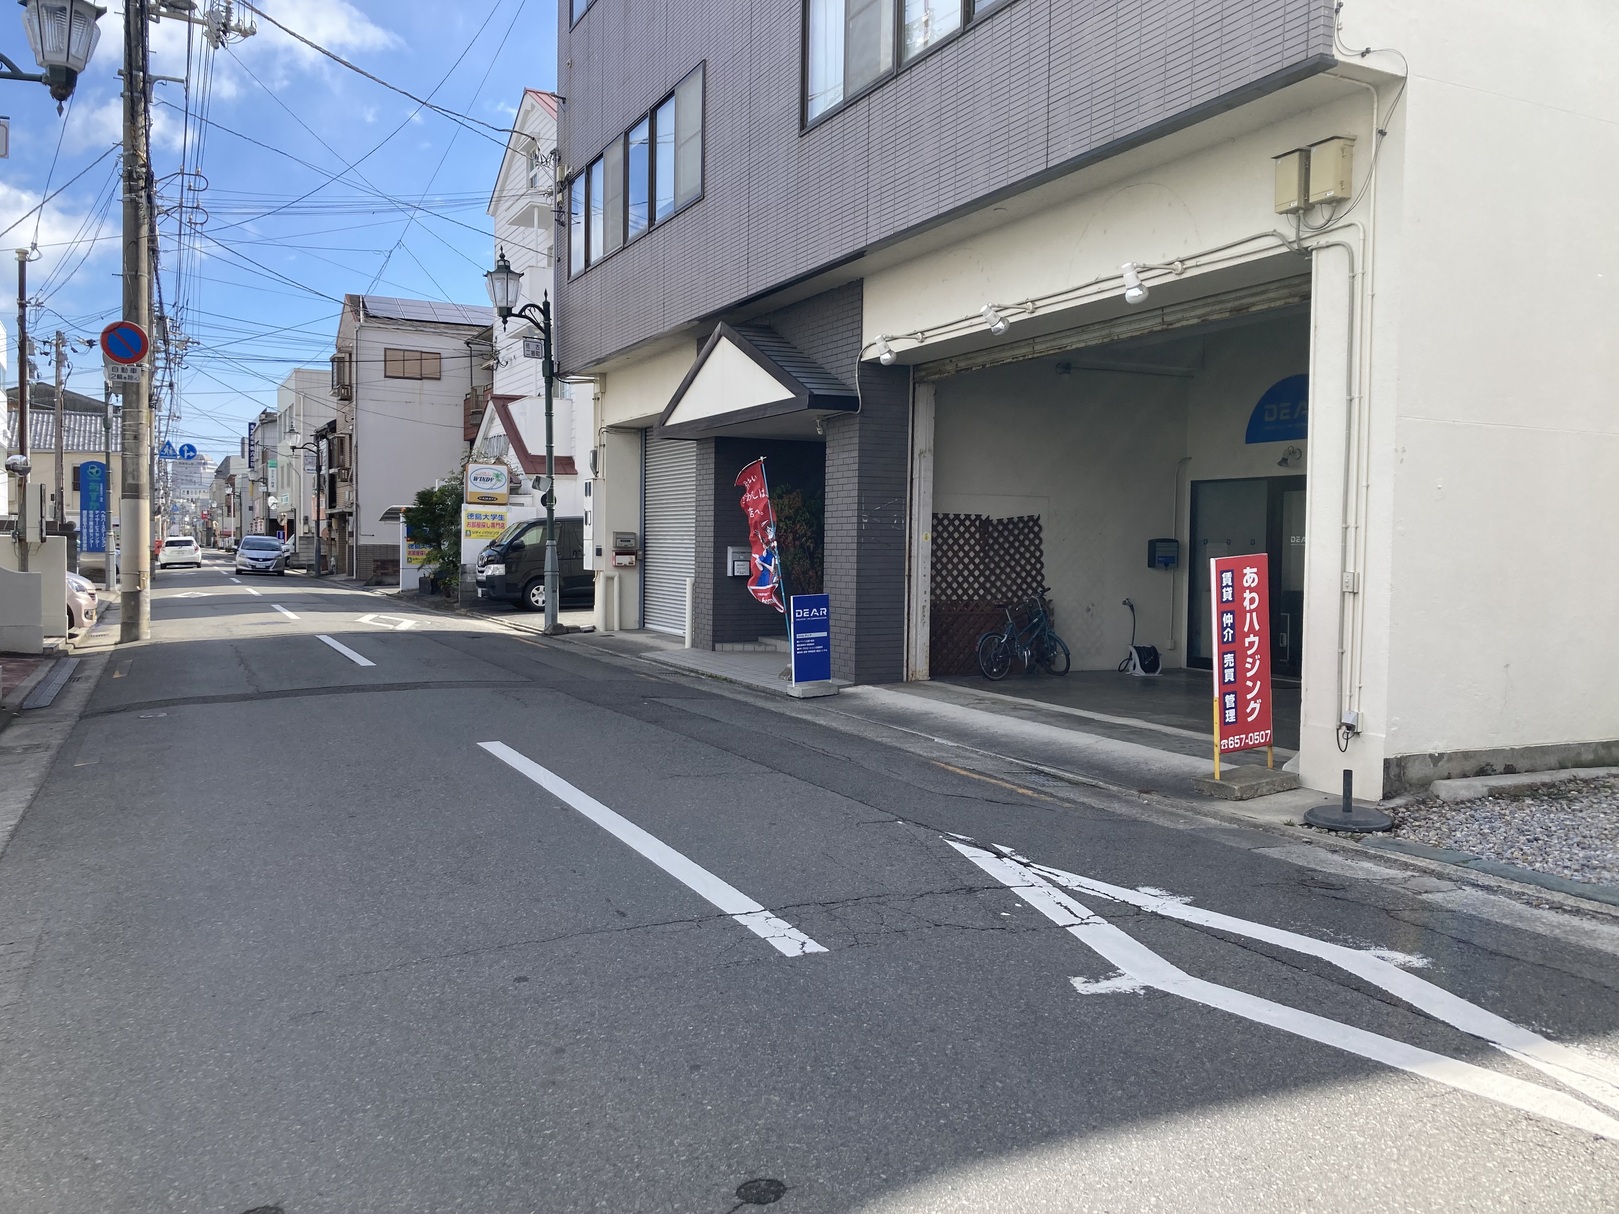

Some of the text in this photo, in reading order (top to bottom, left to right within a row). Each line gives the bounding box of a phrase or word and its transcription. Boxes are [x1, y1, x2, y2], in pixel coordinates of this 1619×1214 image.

[467, 513, 505, 521] 徳島大学生
[467, 521, 505, 529] お部屋探し専門店
[795, 607, 827, 618] DEAR
[1221, 571, 1237, 723] 賃貸 仲介 売買 管理
[1242, 566, 1262, 722] あわハウジング
[1228, 730, 1271, 749] 657-0507
